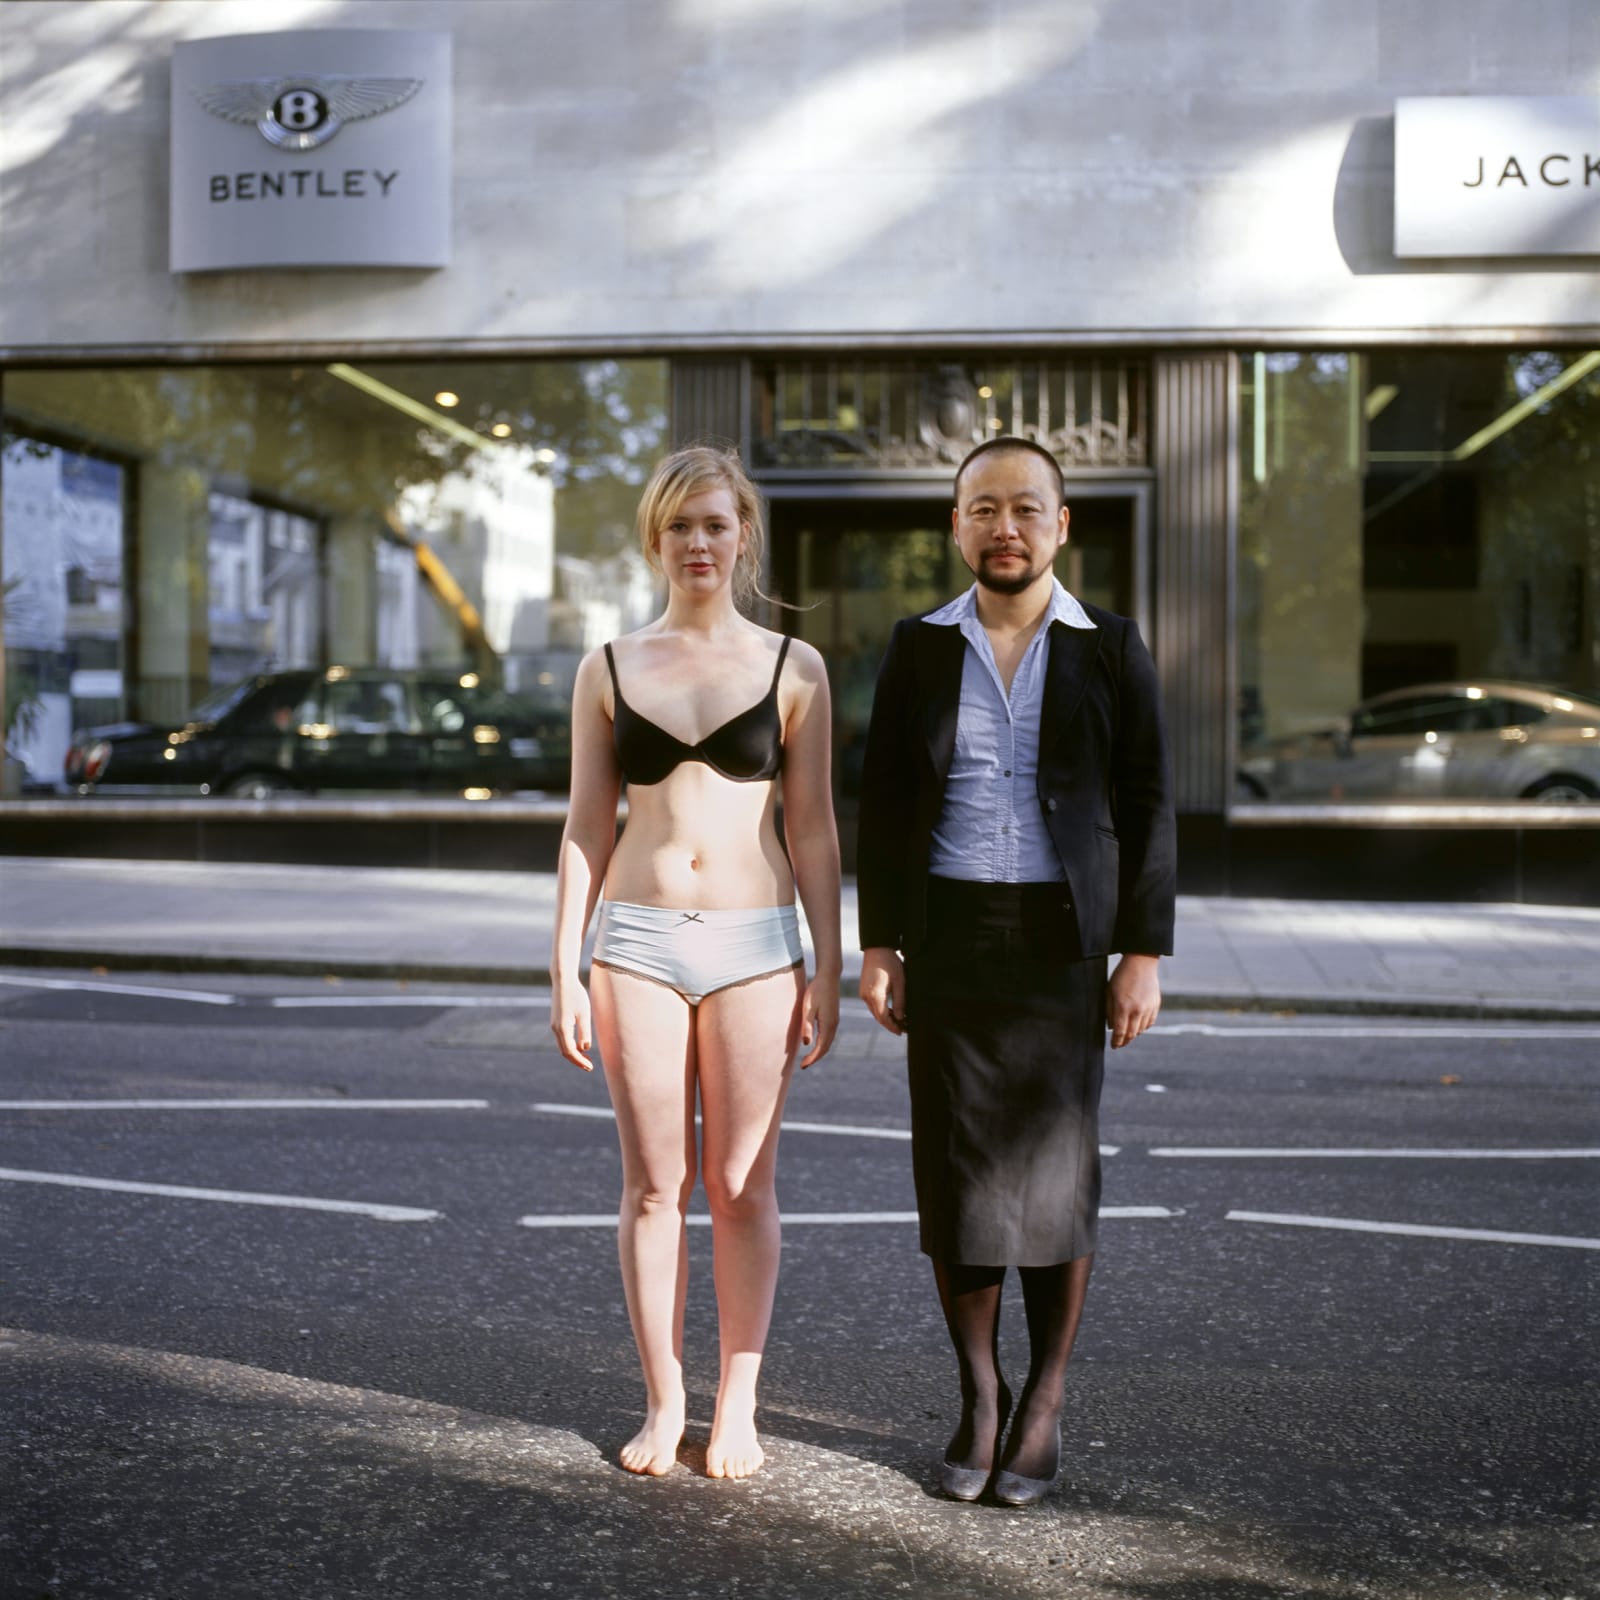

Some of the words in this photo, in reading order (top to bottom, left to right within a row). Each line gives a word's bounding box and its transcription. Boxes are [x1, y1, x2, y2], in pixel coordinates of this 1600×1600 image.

[280, 90, 319, 126] B
[210, 170, 399, 202] BENTLEY
[1463, 154, 1600, 187] JACK
